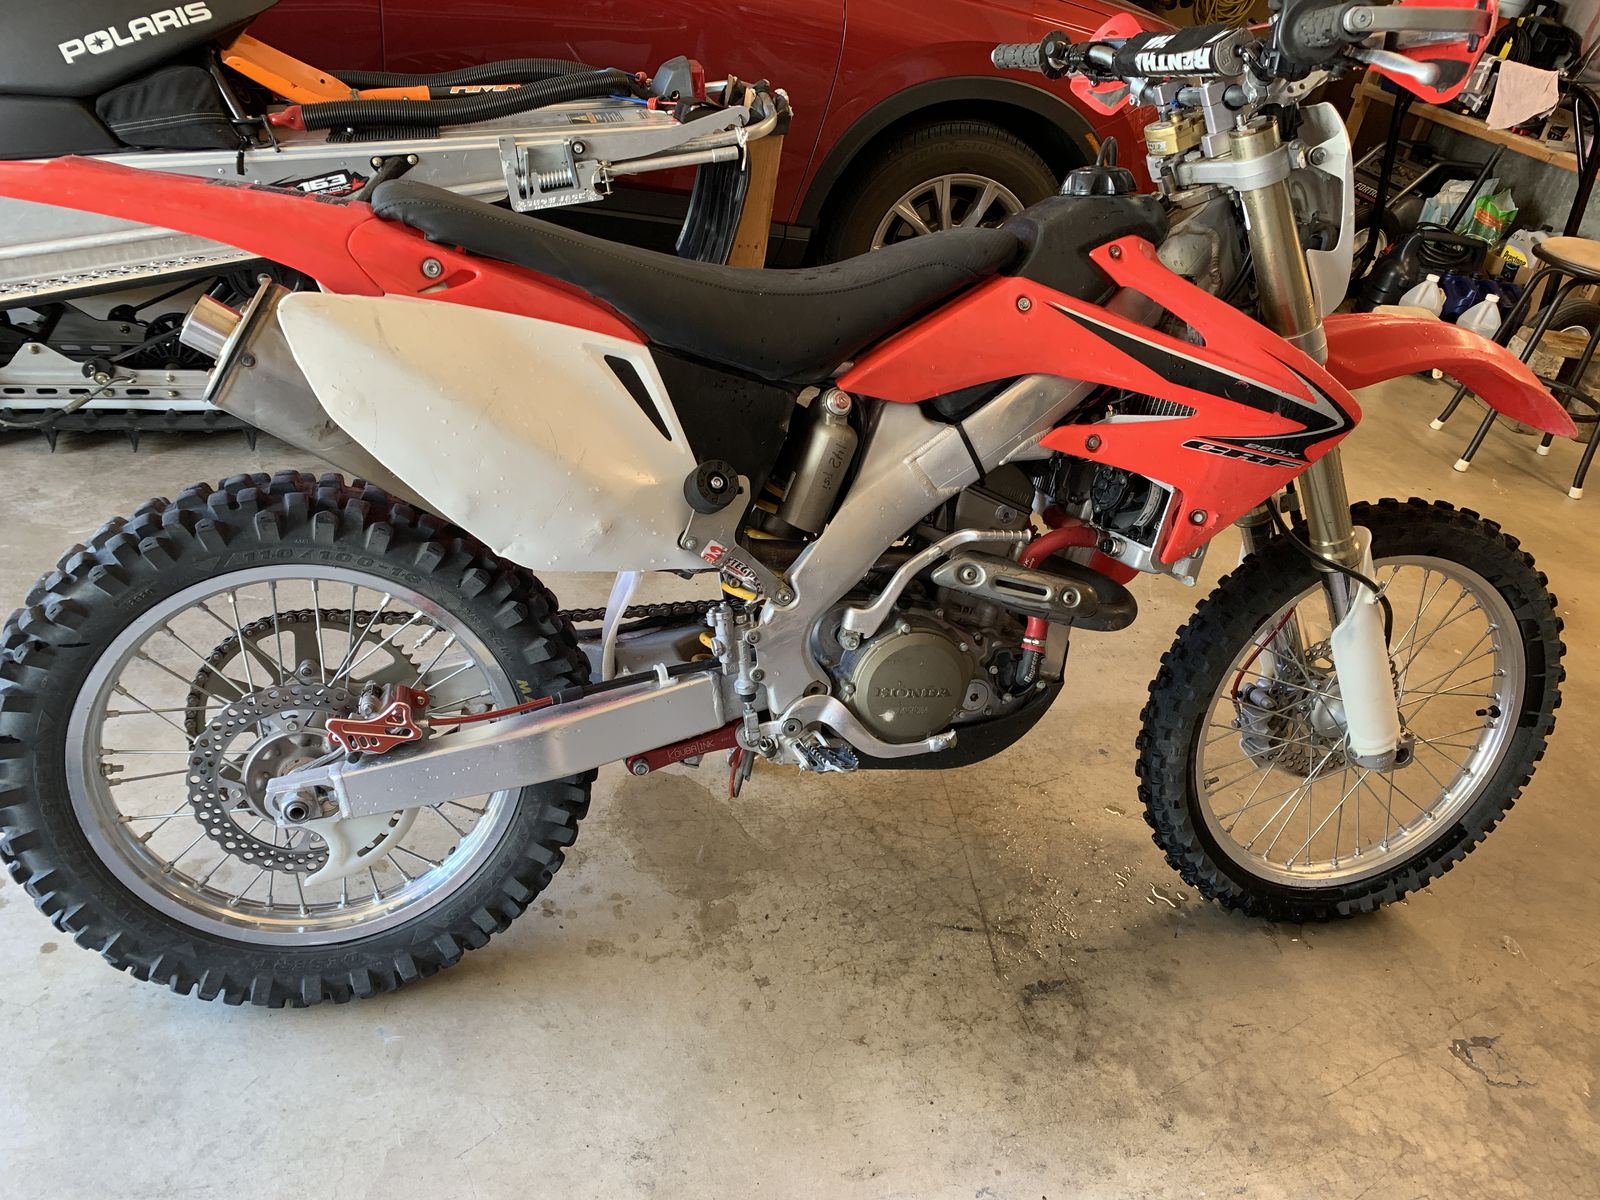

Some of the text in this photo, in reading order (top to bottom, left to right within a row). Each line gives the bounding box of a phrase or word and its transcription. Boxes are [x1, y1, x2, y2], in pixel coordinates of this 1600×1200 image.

[58, 1, 212, 64] POLARIS
[1135, 47, 1211, 72] RENTHA
[297, 174, 347, 192] 163
[1354, 182, 1378, 199] FORTR
[1181, 439, 1304, 468] CRF
[1244, 443, 1300, 458] 250X
[875, 687, 952, 698] HONDA
